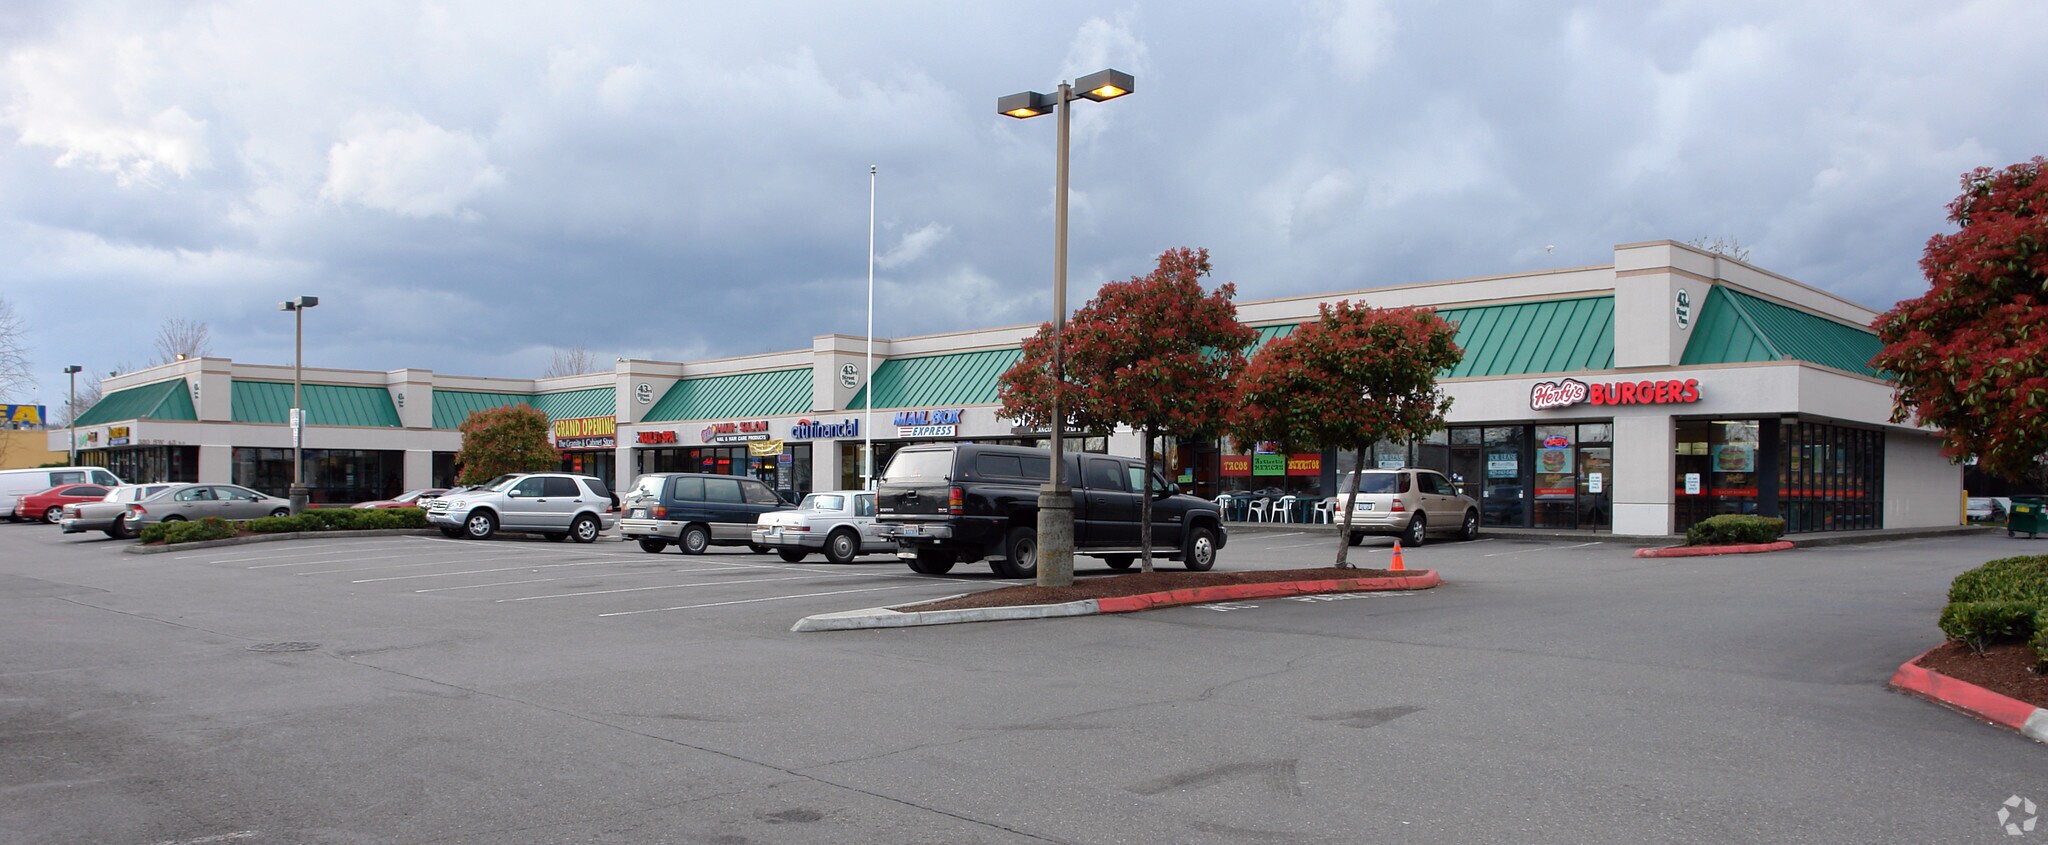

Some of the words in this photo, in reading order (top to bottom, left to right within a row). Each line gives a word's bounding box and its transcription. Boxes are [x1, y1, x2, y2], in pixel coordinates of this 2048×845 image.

[1534, 382, 1585, 408] Herfy's
[1590, 379, 1699, 405] BURGERS
[893, 411, 929, 426] MAIL
[931, 408, 964, 425] BOX
[555, 420, 580, 437] GRAND
[582, 416, 615, 436] OPENING
[716, 422, 737, 433] HAIR
[739, 420, 768, 432] SALON
[791, 419, 859, 439] citifinancial
[912, 426, 952, 436] EXPRESS
[558, 440, 566, 448] The
[1545, 437, 1569, 447] OPEN
[1224, 461, 1248, 471] TACOS
[1288, 459, 1320, 471] BURRITOS
